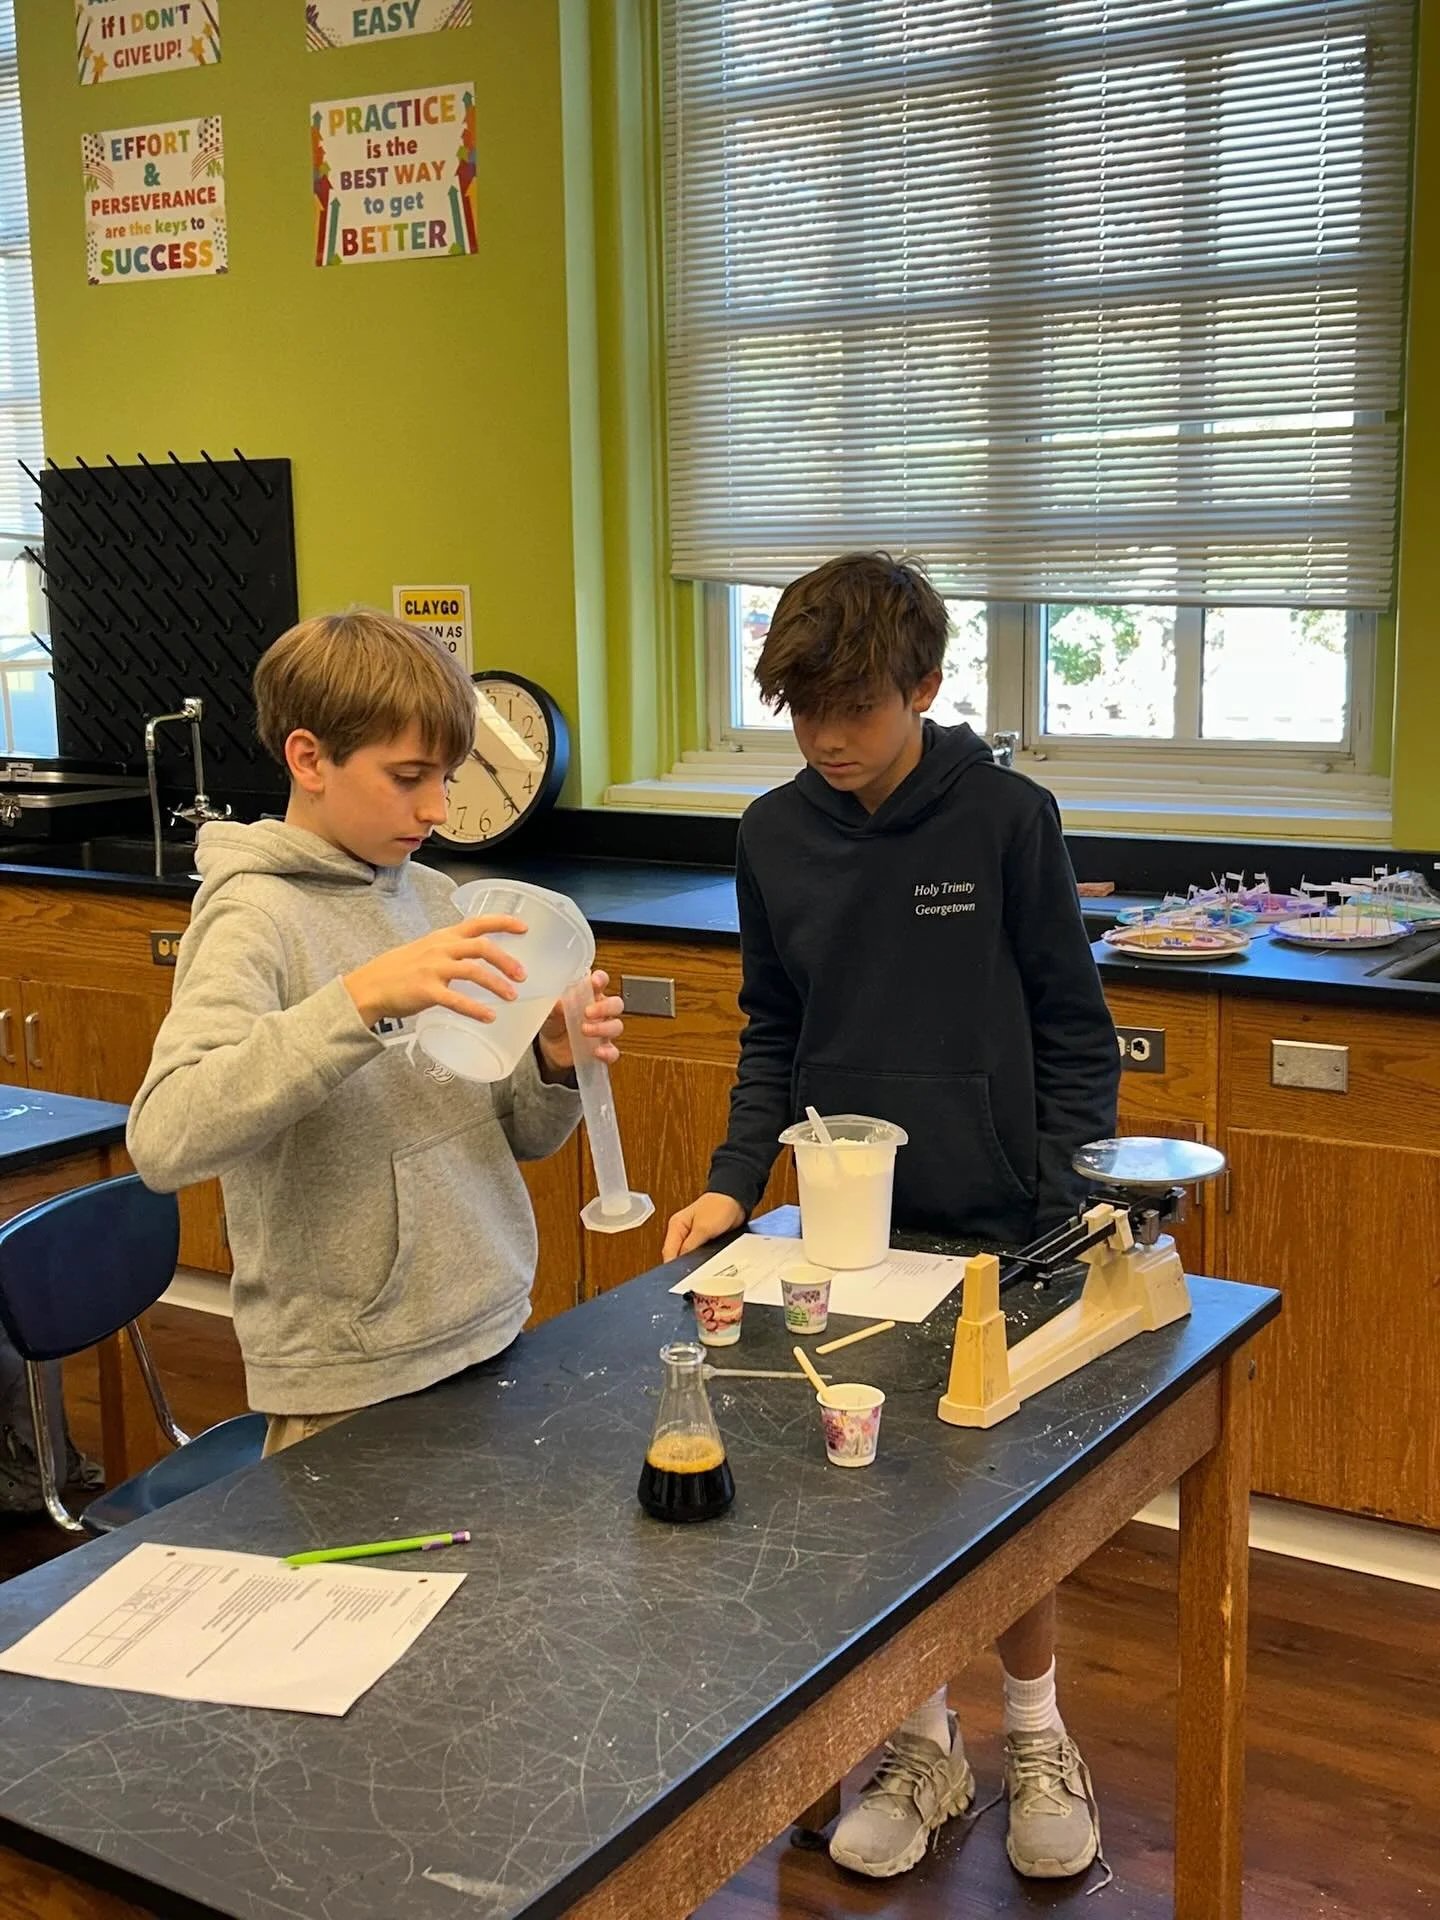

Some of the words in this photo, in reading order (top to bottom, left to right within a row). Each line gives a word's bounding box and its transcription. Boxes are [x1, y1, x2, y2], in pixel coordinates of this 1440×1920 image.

[131, 4, 190, 33] DON'T
[353, 0, 421, 38] EASY
[113, 45, 152, 69] GIVE
[154, 39, 182, 62] UP!
[328, 94, 456, 136] PRACTICE
[111, 129, 190, 162] EFFORT
[366, 138, 381, 159] is
[386, 136, 418, 156] the
[143, 162, 160, 187] &
[340, 166, 389, 191] BEST
[394, 160, 446, 184] WAY
[91, 186, 217, 217] PERSEVERANCE
[364, 196, 385, 214] to
[390, 191, 424, 218] get
[105, 225, 127, 239] are
[130, 220, 152, 237] the
[155, 218, 188, 237] keys
[190, 216, 205, 231] to
[342, 219, 448, 257] BETTER
[101, 239, 214, 277] SUCCESS
[405, 600, 459, 615] CLAYGO
[446, 625, 463, 638] AS
[522, 715, 535, 739] 2
[521, 770, 535, 795] 4
[456, 806, 468, 830] 7
[479, 808, 492, 833] 6
[914, 883, 940, 897] Holy
[941, 881, 975, 894] Trinity
[915, 902, 976, 916] Georgetown
